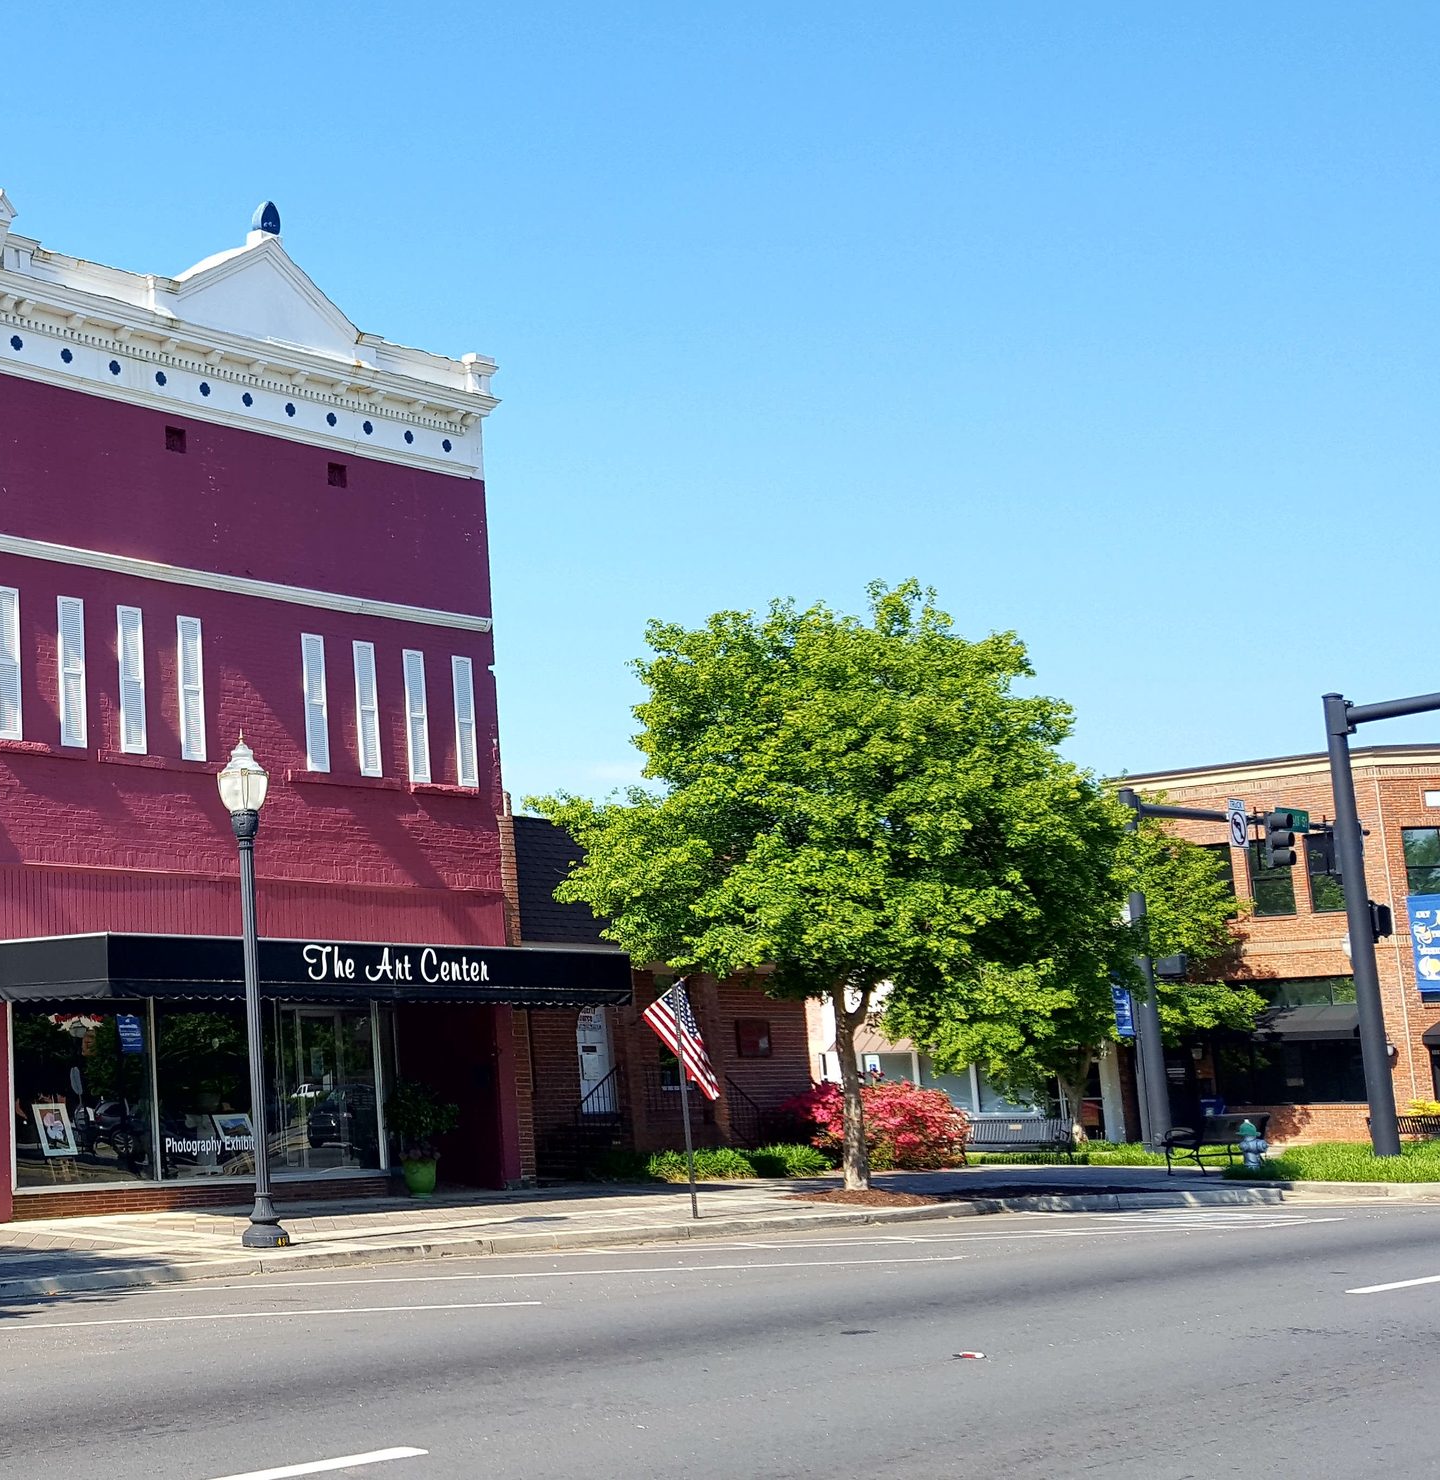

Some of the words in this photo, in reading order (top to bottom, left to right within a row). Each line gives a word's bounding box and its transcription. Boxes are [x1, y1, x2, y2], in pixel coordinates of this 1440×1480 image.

[303, 944, 355, 981] The
[365, 947, 412, 981] Art
[421, 948, 490, 983] Center
[165, 1136, 222, 1156] Photography
